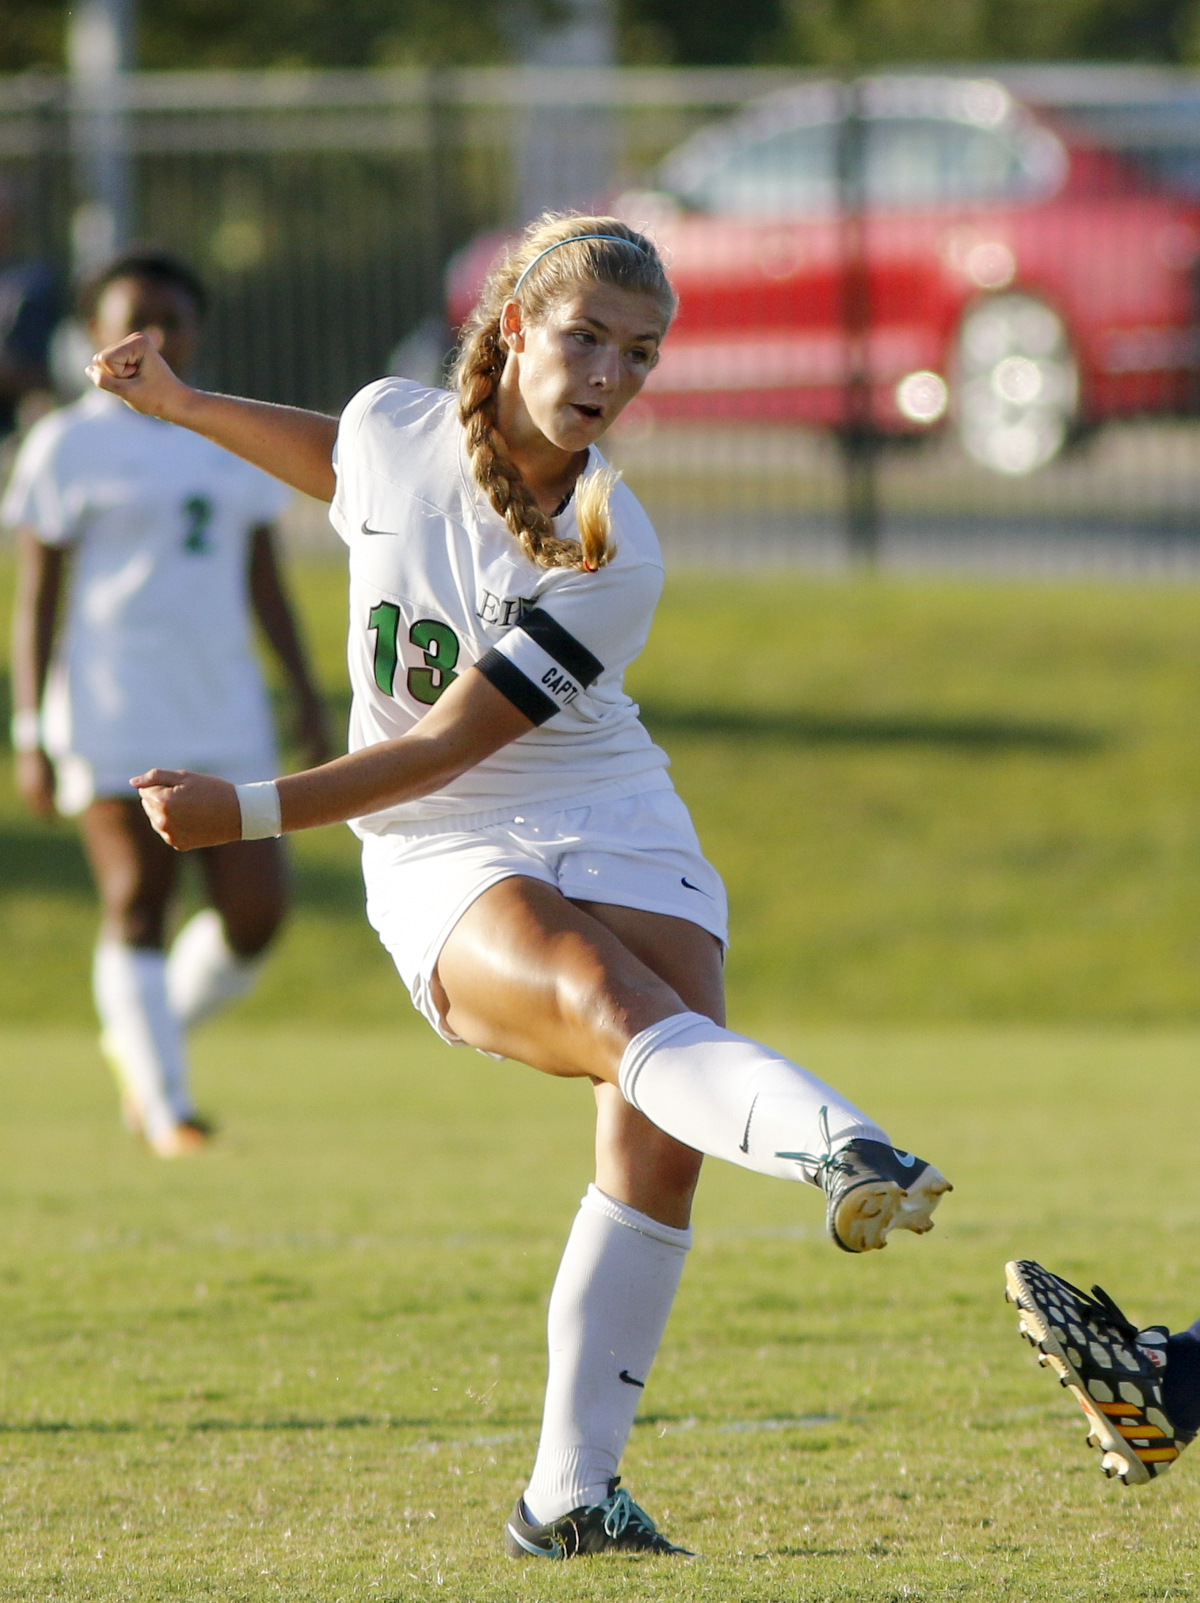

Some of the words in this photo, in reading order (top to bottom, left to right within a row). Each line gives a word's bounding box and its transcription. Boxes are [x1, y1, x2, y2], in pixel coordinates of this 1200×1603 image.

[182, 492, 214, 555] 2
[367, 599, 460, 706] 13
[541, 667, 580, 705] CAPT
